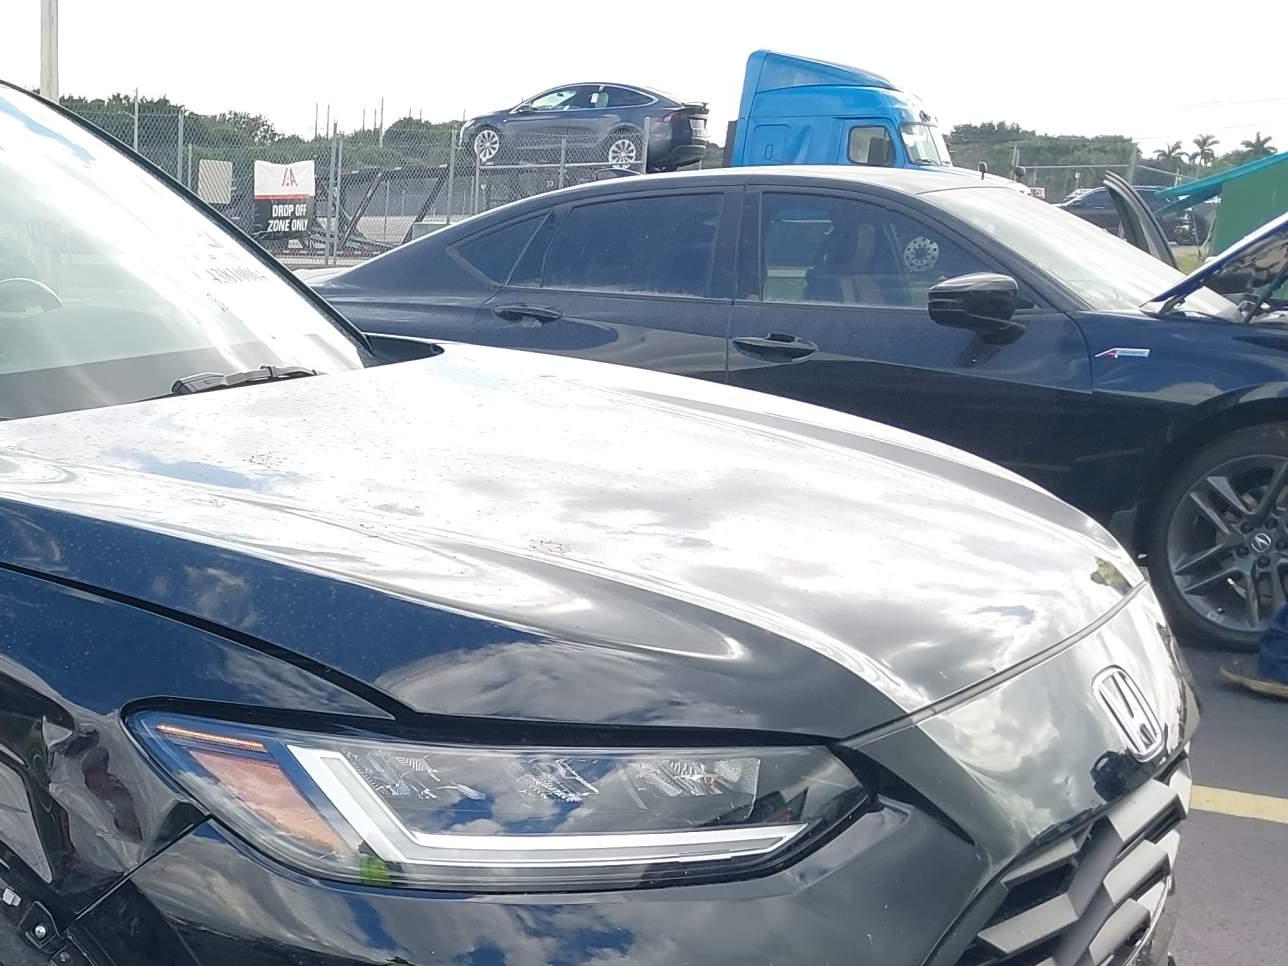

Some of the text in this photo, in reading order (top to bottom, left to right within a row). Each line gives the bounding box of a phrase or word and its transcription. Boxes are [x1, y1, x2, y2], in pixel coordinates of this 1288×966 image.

[272, 203, 308, 217] DROP OFF
[267, 218, 309, 232] ZONE ONLY
